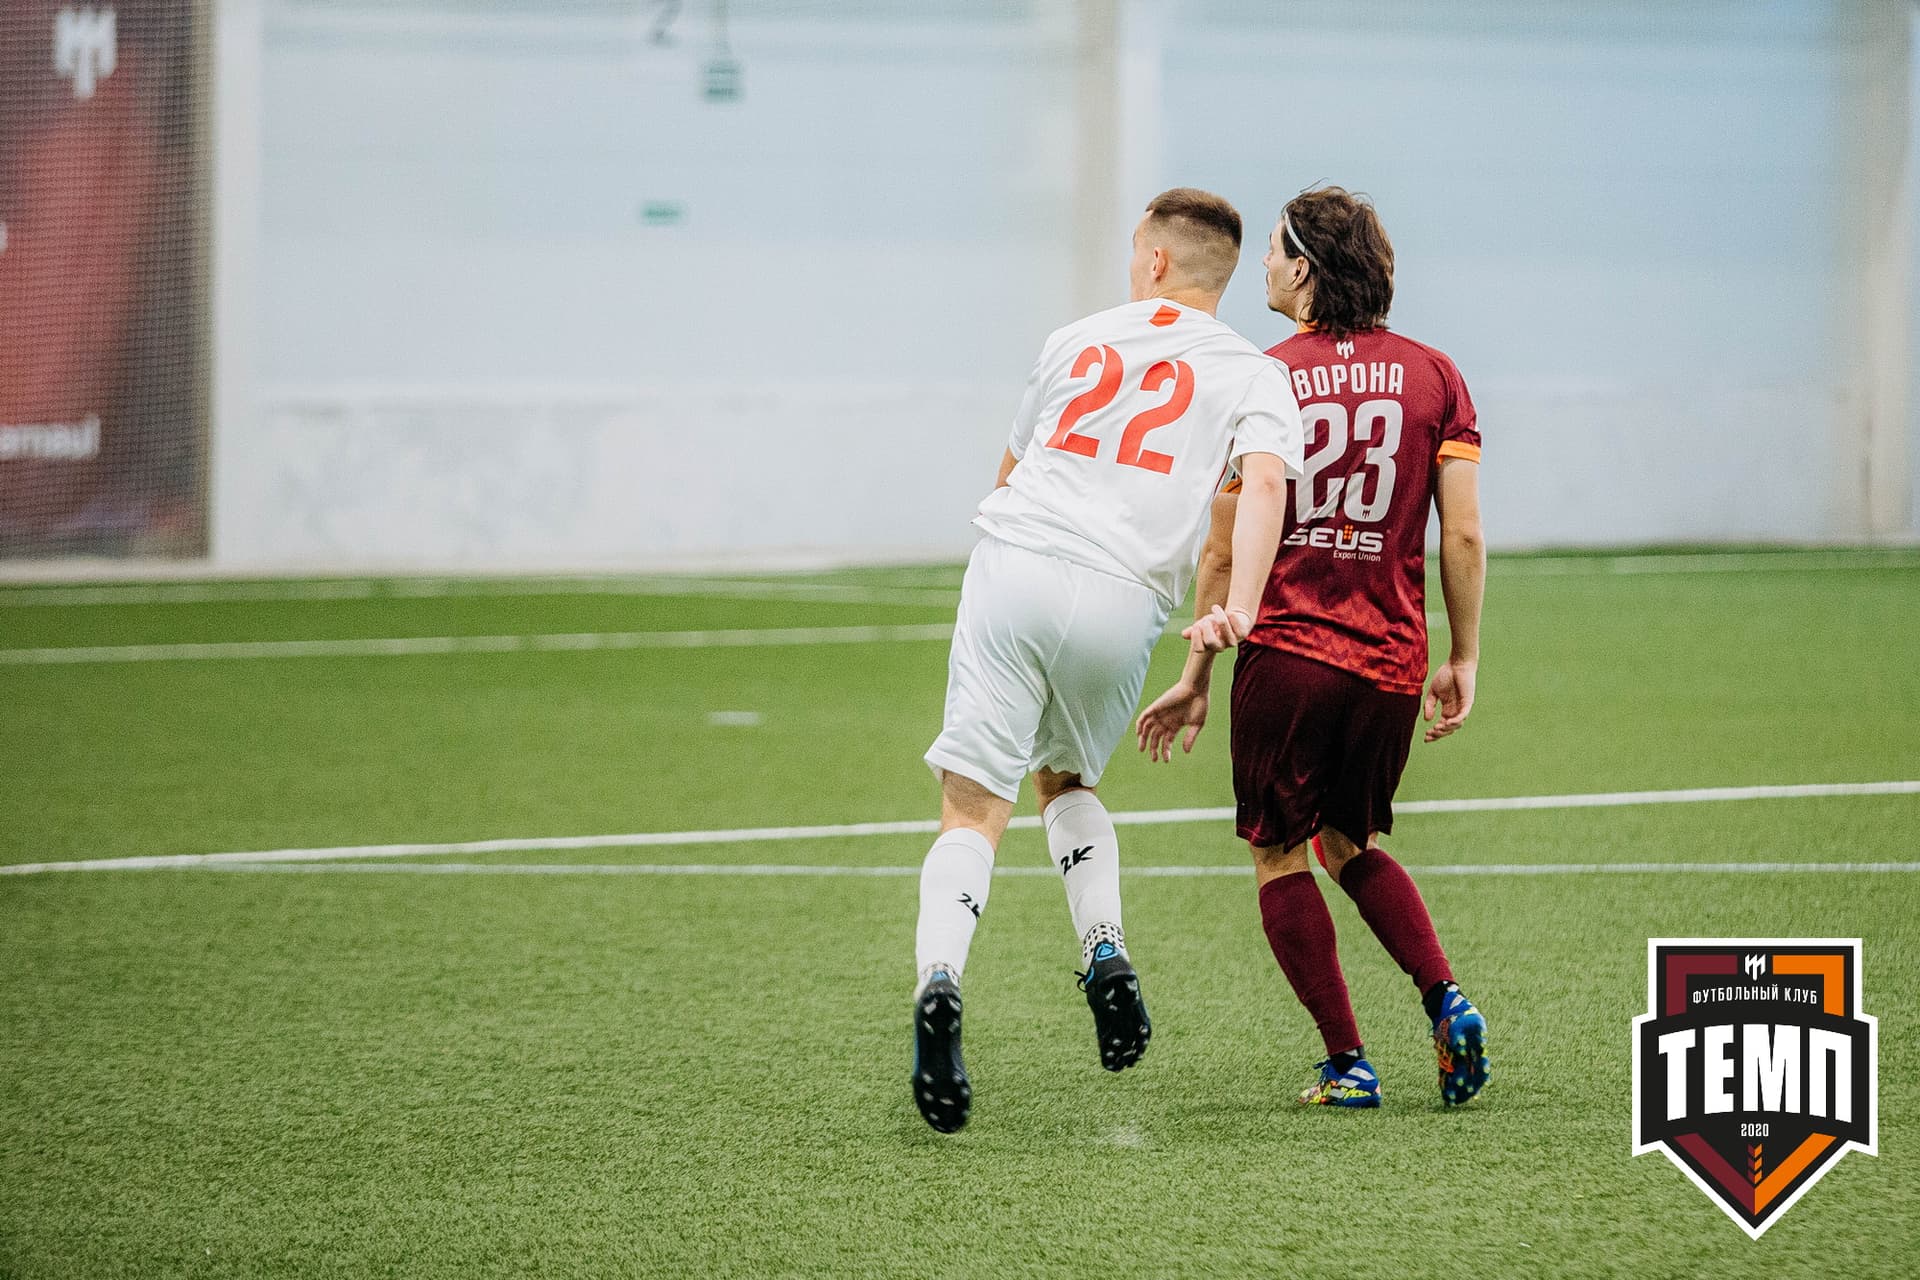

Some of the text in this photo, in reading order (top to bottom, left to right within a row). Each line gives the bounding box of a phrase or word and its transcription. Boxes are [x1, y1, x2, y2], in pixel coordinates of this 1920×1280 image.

[1291, 362, 1404, 401] ВОРОНА
[1044, 343, 1196, 475] 22
[1295, 399, 1404, 523] 23
[1333, 549, 1381, 561] Export Union
[1060, 845, 1095, 876] 2K
